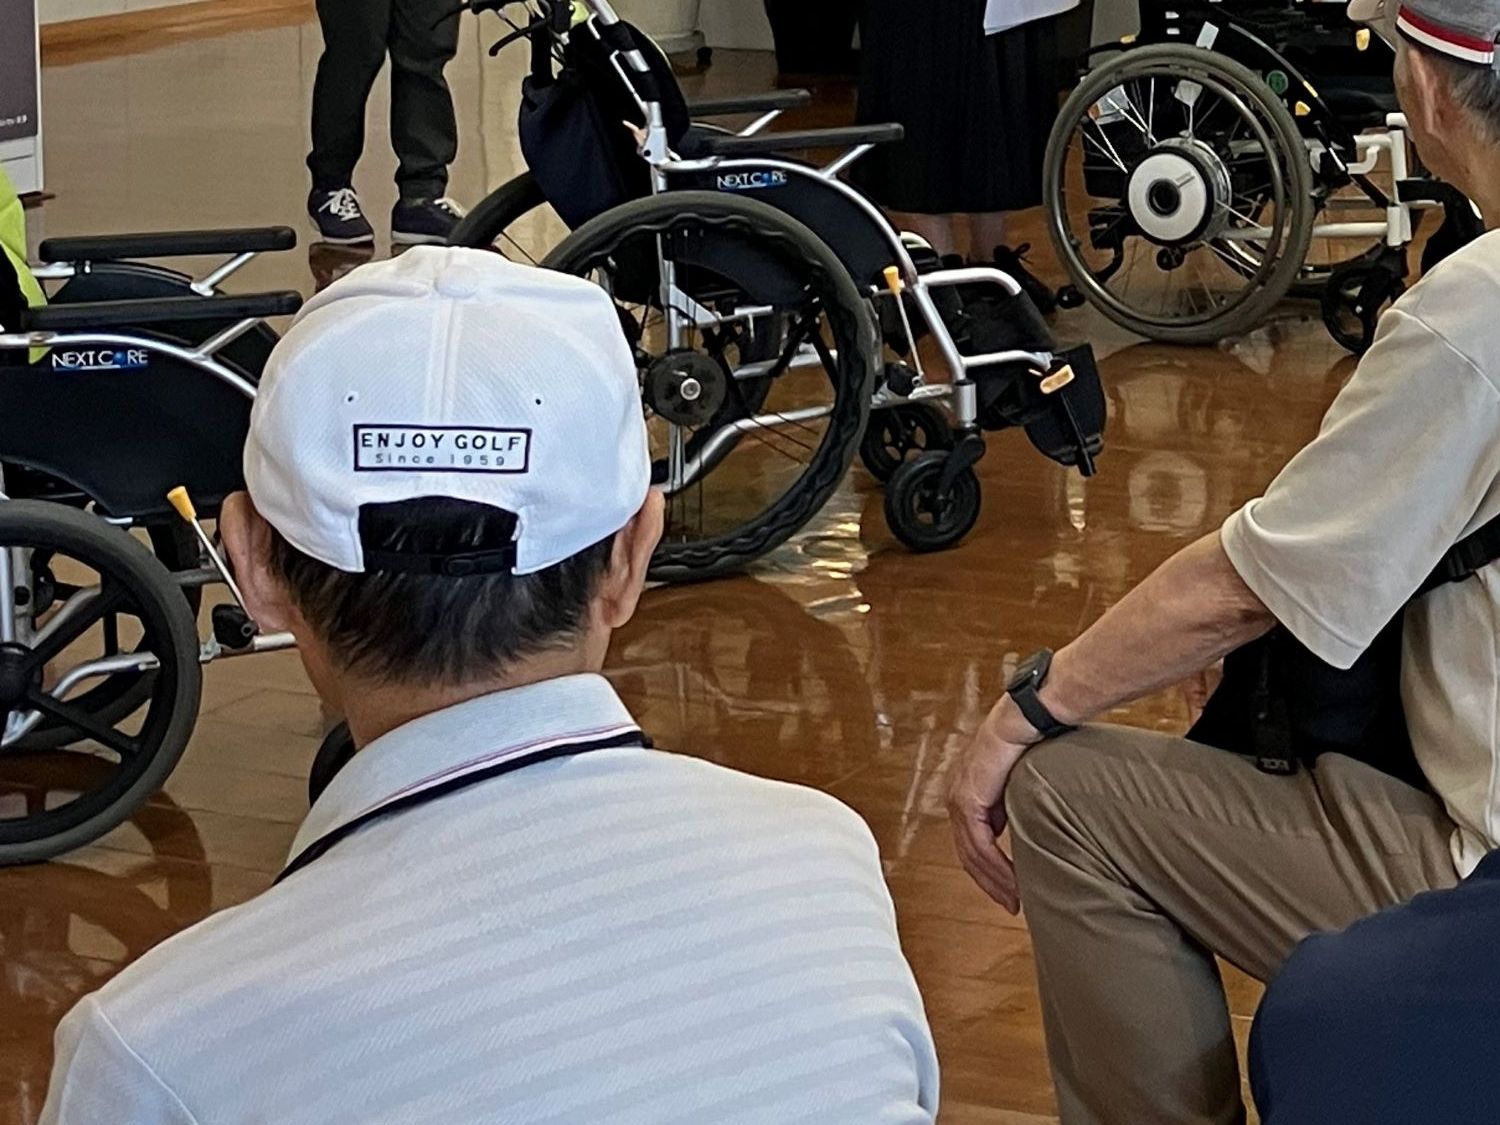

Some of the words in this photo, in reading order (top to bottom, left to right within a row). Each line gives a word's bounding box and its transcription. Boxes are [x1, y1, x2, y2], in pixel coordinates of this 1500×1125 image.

[361, 432, 445, 449] ENJOY
[454, 433, 521, 451] GOLF
[375, 453, 435, 465] Since
[450, 453, 505, 467] 1959
